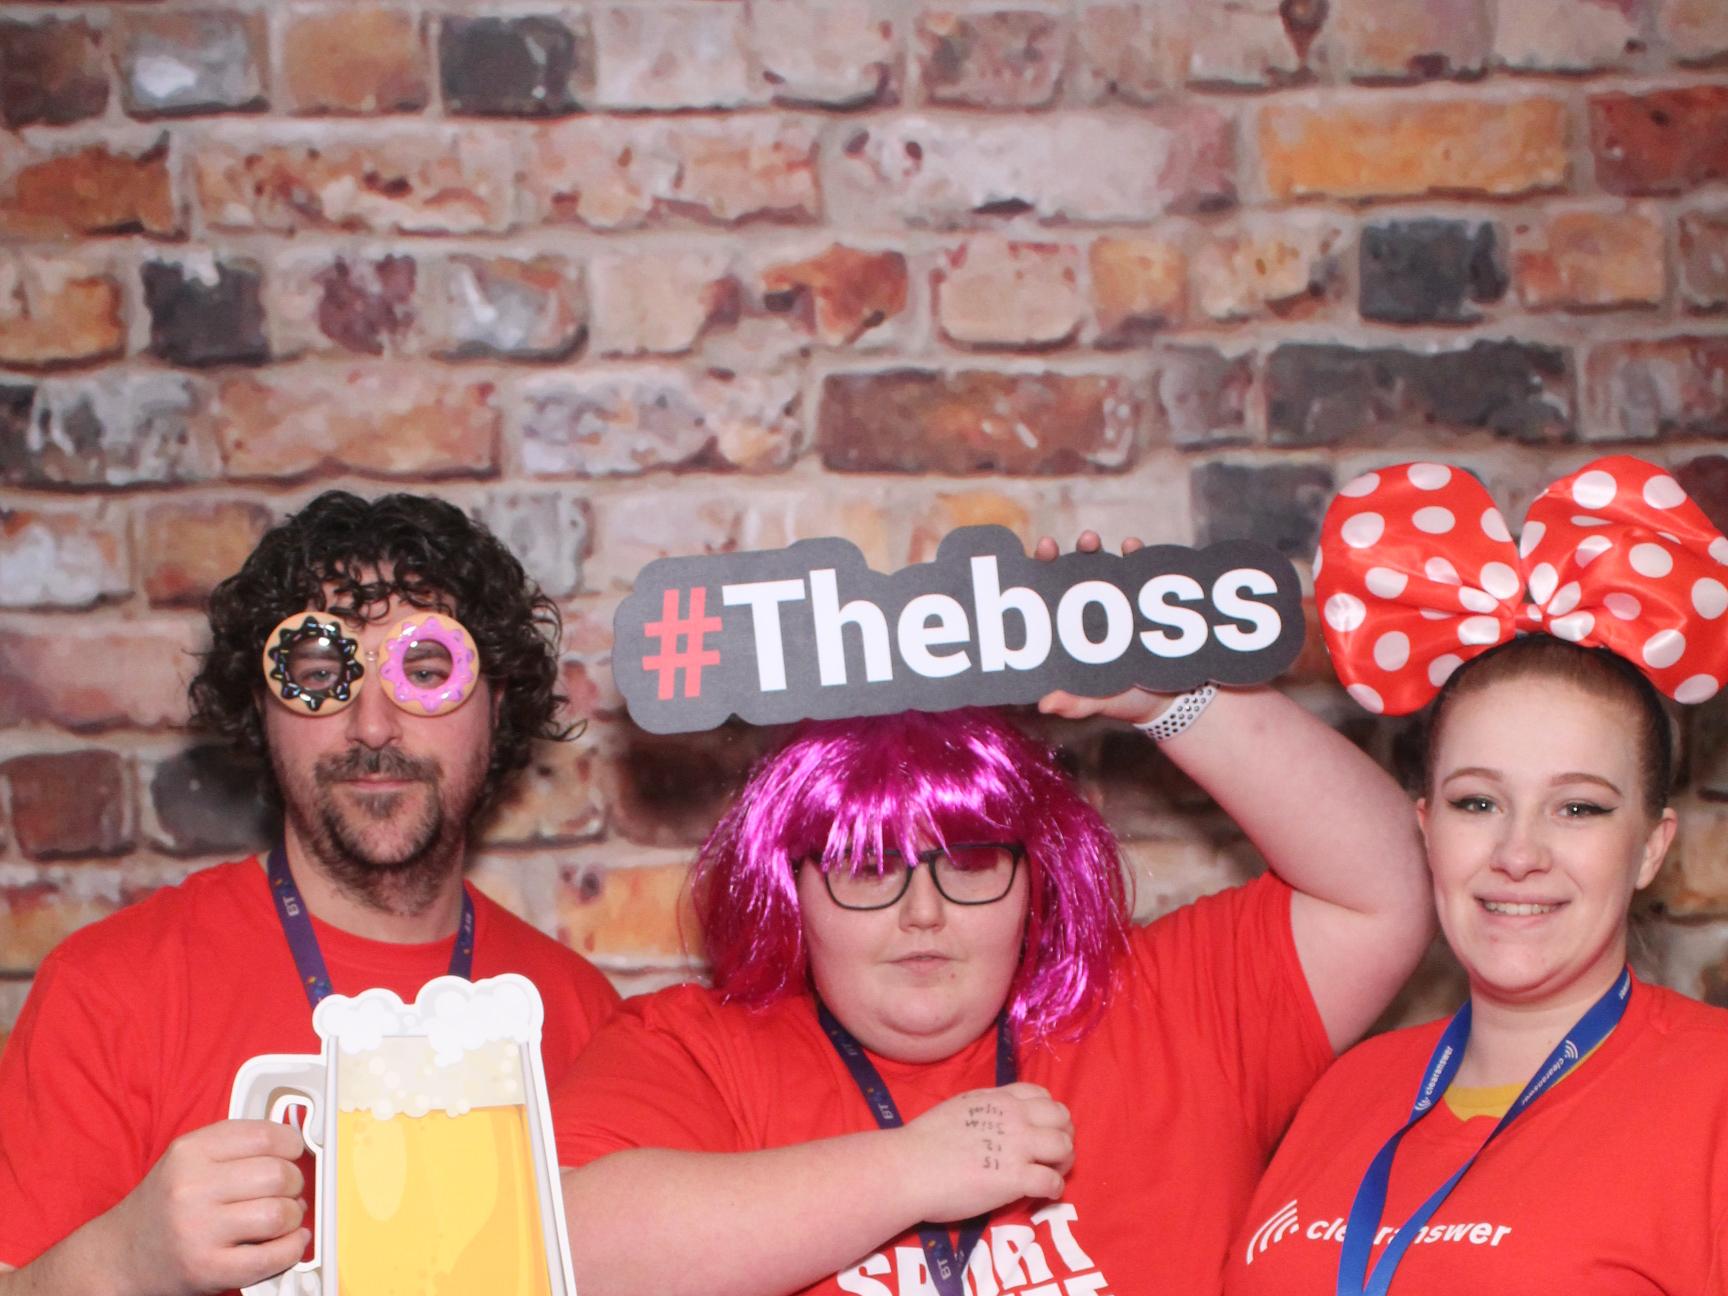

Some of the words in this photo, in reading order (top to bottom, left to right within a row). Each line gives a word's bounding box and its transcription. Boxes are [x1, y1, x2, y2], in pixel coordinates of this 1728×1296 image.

[642, 556, 1282, 701] #Theboss
[283, 896, 300, 917] BT
[1426, 1045, 1454, 1096] clearanswer
[878, 1103, 895, 1121] BT
[937, 1258, 952, 1281] BT
